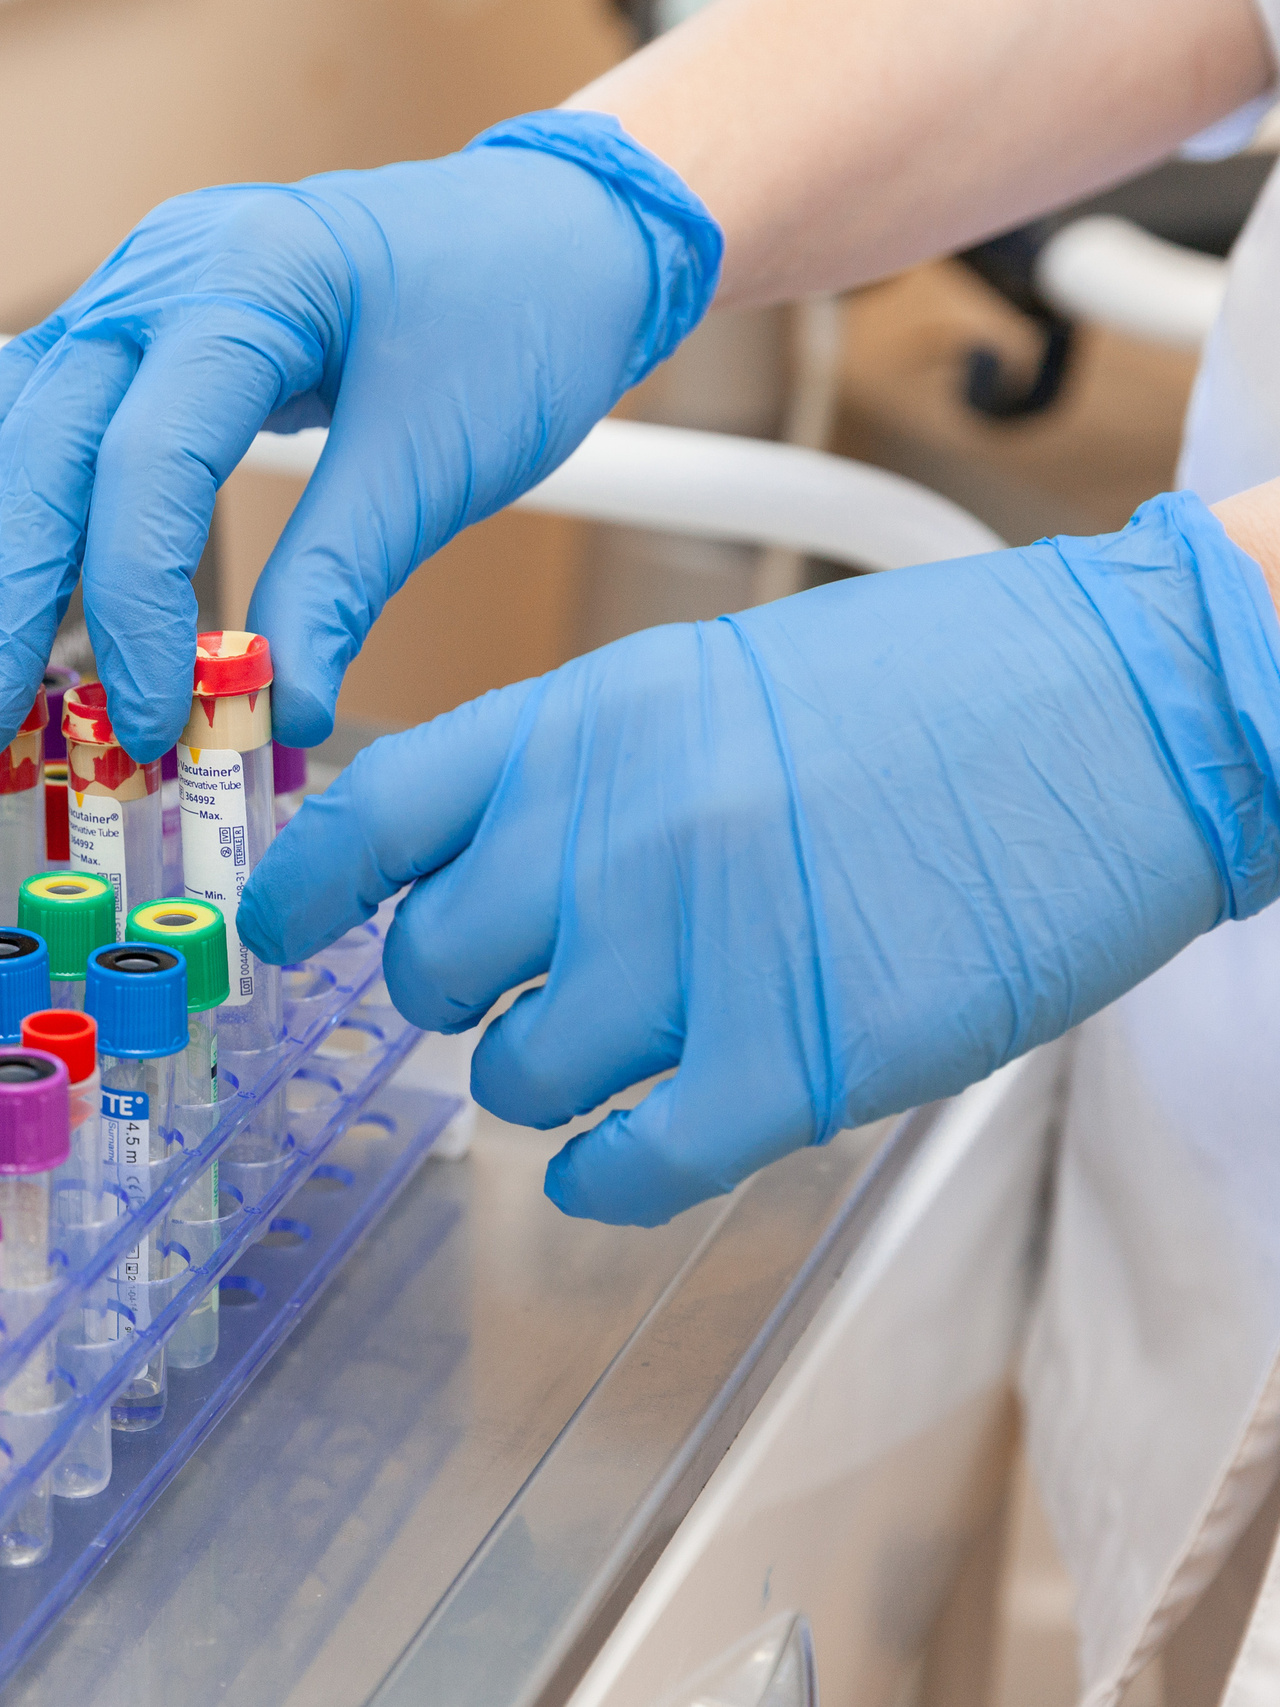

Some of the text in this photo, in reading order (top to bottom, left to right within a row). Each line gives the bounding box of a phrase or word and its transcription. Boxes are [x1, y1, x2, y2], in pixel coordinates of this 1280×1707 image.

[219, 781, 242, 791] Tube
[185, 791, 216, 805] 364992
[199, 810, 223, 821] Max.
[98, 828, 120, 838] Tube
[221, 829, 229, 842] IVD
[235, 838, 244, 865] STERILE
[80, 854, 101, 866] Max.
[204, 890, 226, 901] Min.
[243, 980, 251, 993] LOT
[126, 1122, 140, 1146] 4.5
